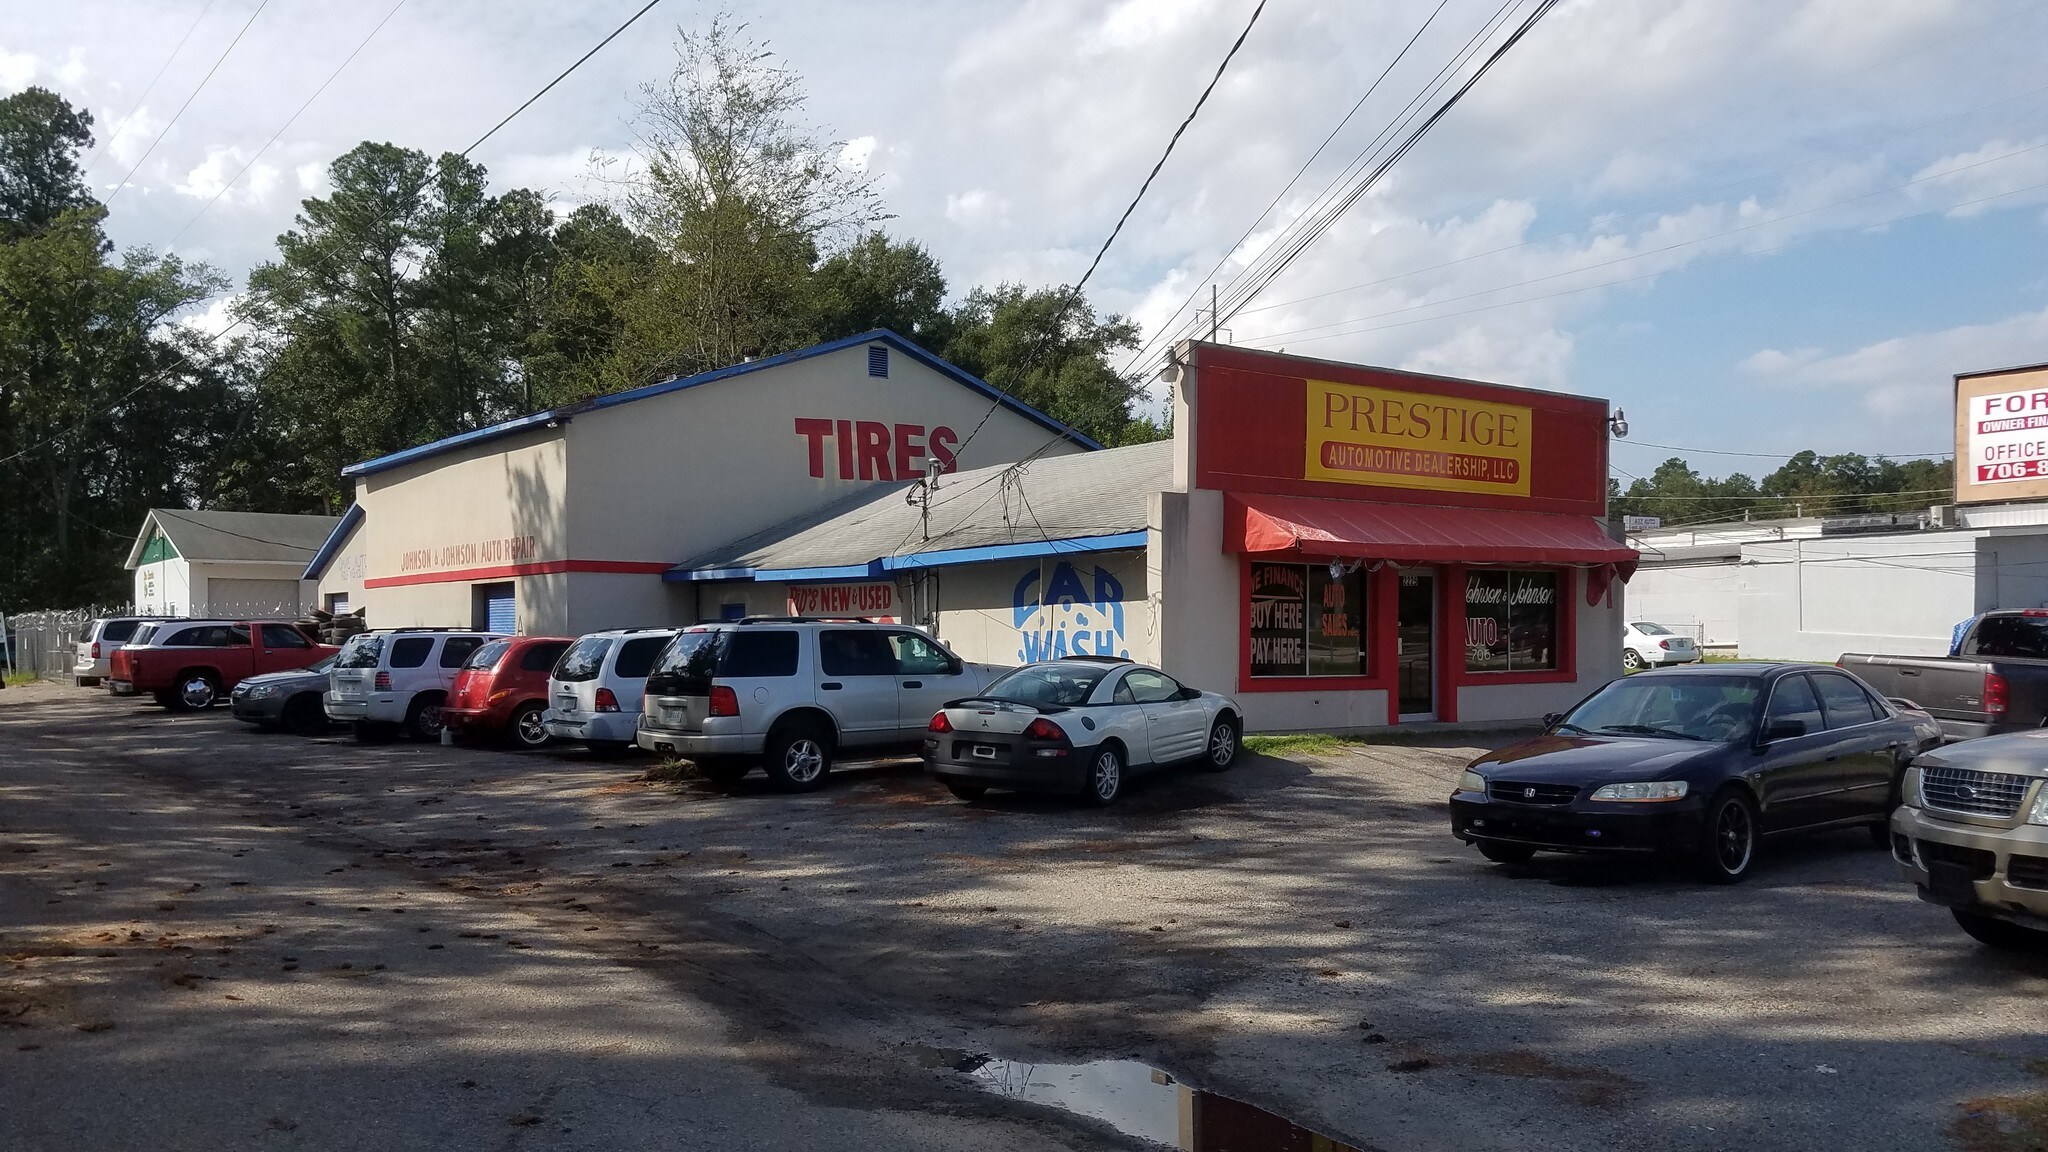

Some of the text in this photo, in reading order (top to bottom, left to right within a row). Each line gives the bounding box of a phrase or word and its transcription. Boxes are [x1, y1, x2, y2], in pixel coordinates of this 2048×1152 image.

[1985, 392, 2048, 415] FOR
[1323, 392, 1520, 448] PRESTIGE
[1982, 418, 2025, 432] OWNER
[795, 418, 958, 482] TIRES
[1329, 444, 1514, 480] AUTOMOTIVE DEALERSHIP, LLC
[1985, 441, 2046, 460] OFFICE
[401, 548, 432, 571] JOHNSON
[441, 542, 476, 566] JOHNSON
[481, 538, 501, 562] AUTO
[504, 535, 535, 560] REPAIR
[1264, 566, 1305, 599] FINANCE
[1323, 584, 1345, 609] AUTO
[1510, 578, 1554, 606] Johnson
[821, 586, 851, 612] NEW
[859, 585, 892, 611] USED
[1013, 561, 1125, 642] CAR
[1251, 602, 1303, 629] BUY HERE
[1321, 613, 1348, 637] SALES
[1022, 629, 1114, 664] WASH
[1251, 637, 1301, 665] PAY HERE
